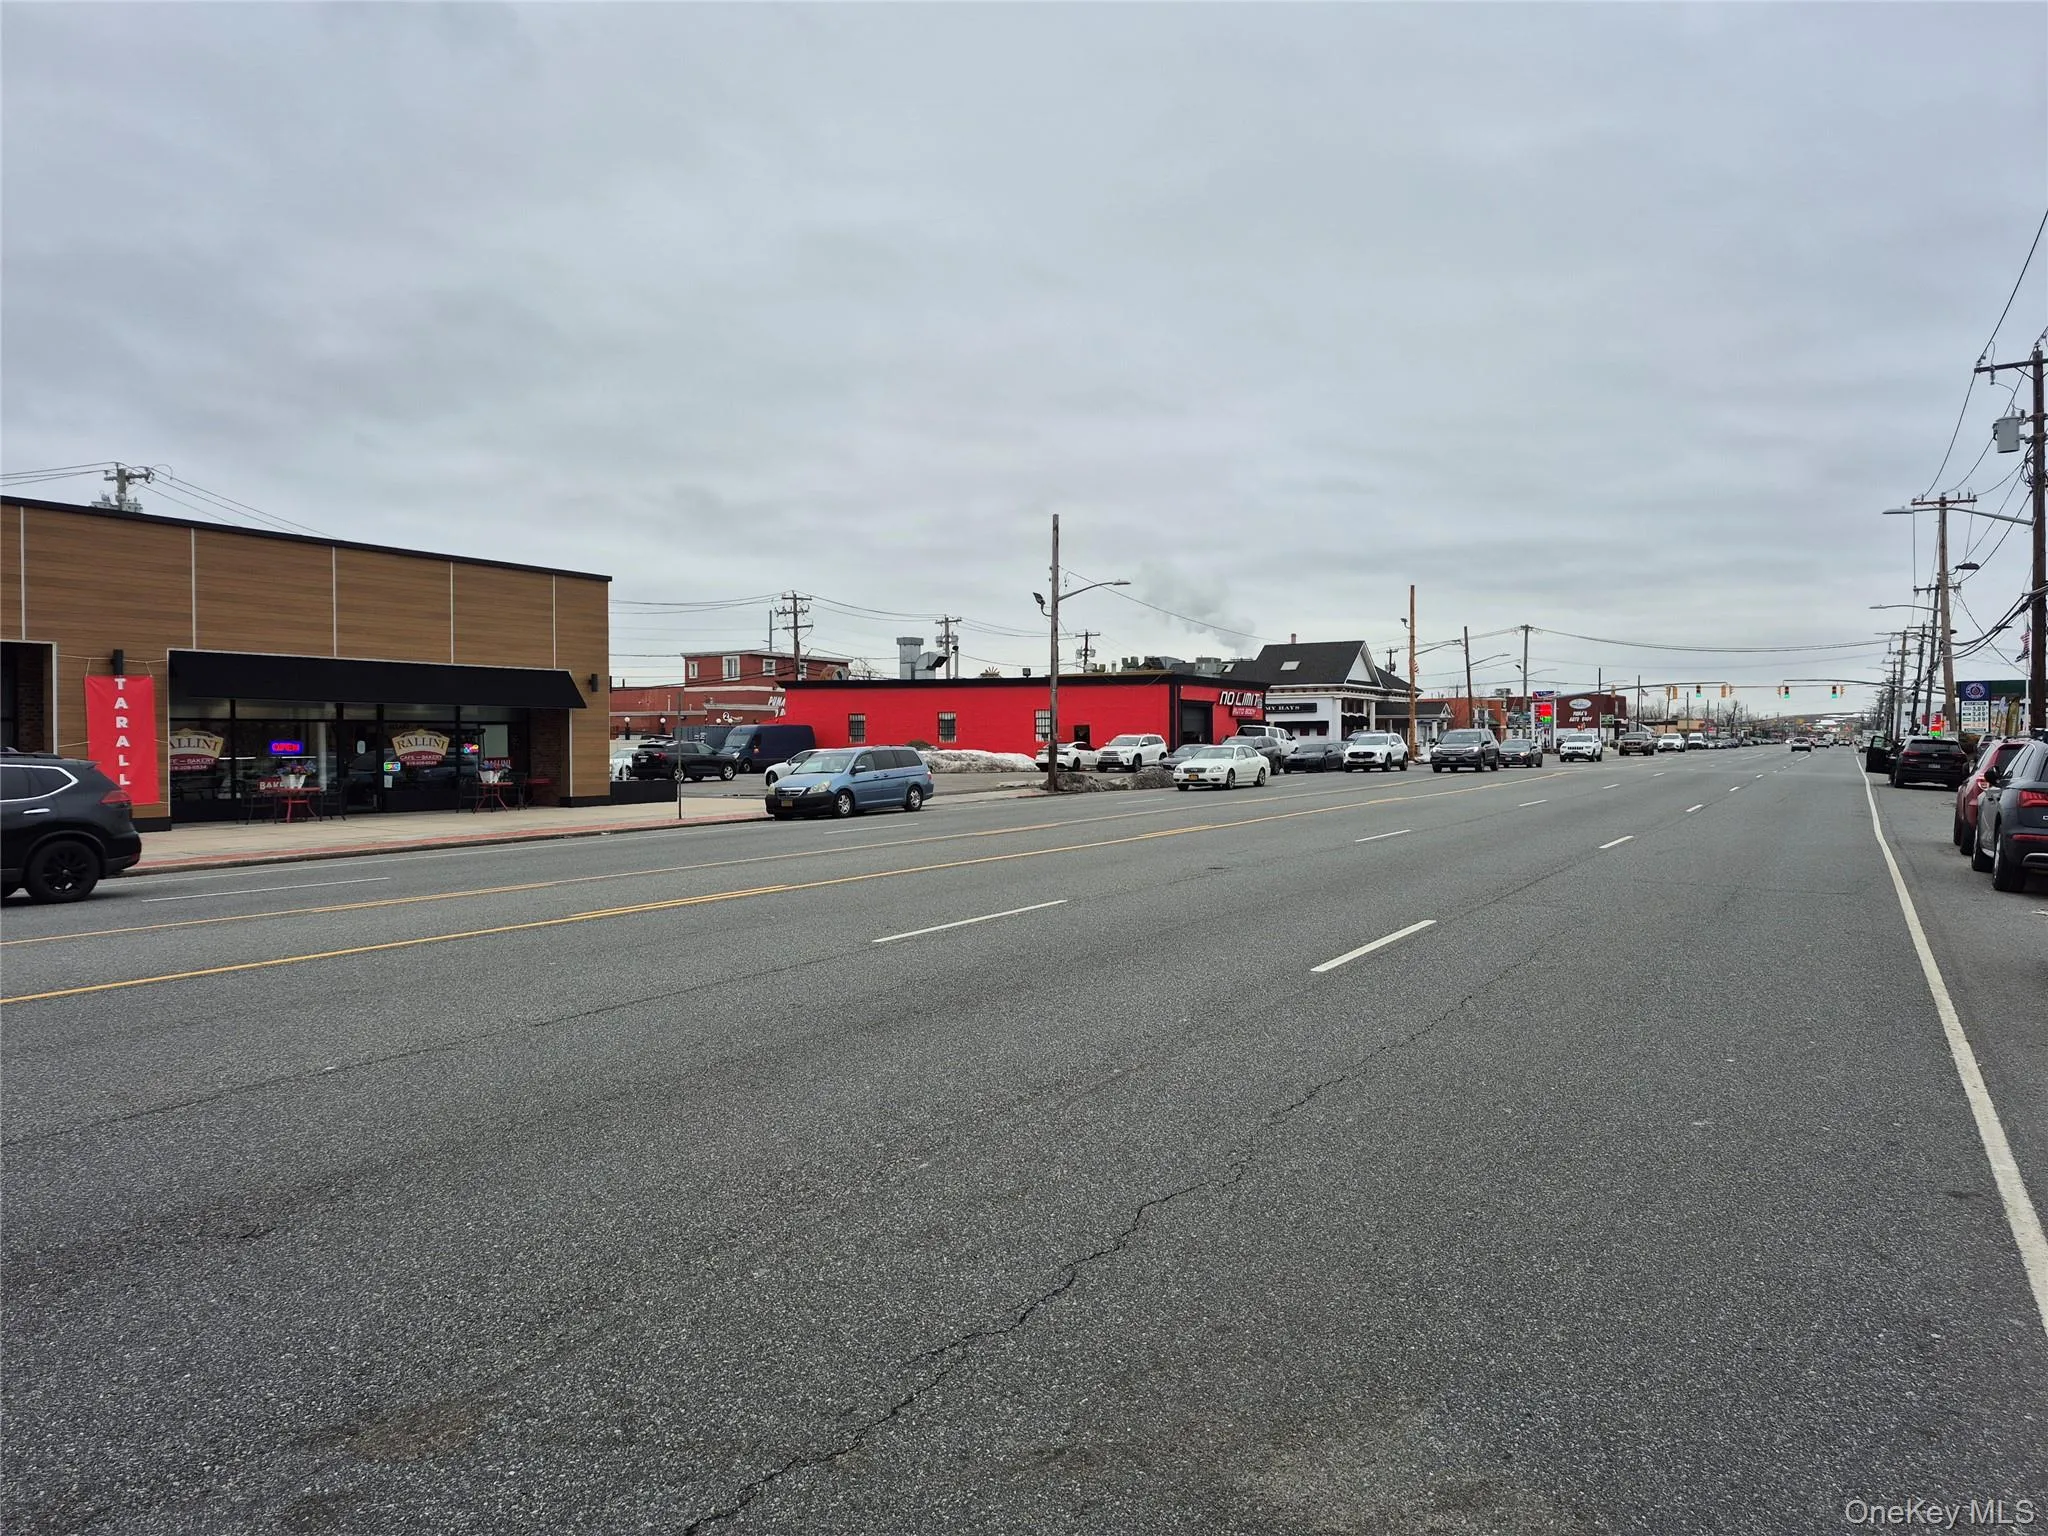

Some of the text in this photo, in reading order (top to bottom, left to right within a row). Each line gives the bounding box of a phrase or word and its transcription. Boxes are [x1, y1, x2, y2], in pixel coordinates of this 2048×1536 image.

[1219, 691, 1235, 705] NO
[170, 737, 219, 751] ALLINI
[395, 736, 447, 749] RALLINI
